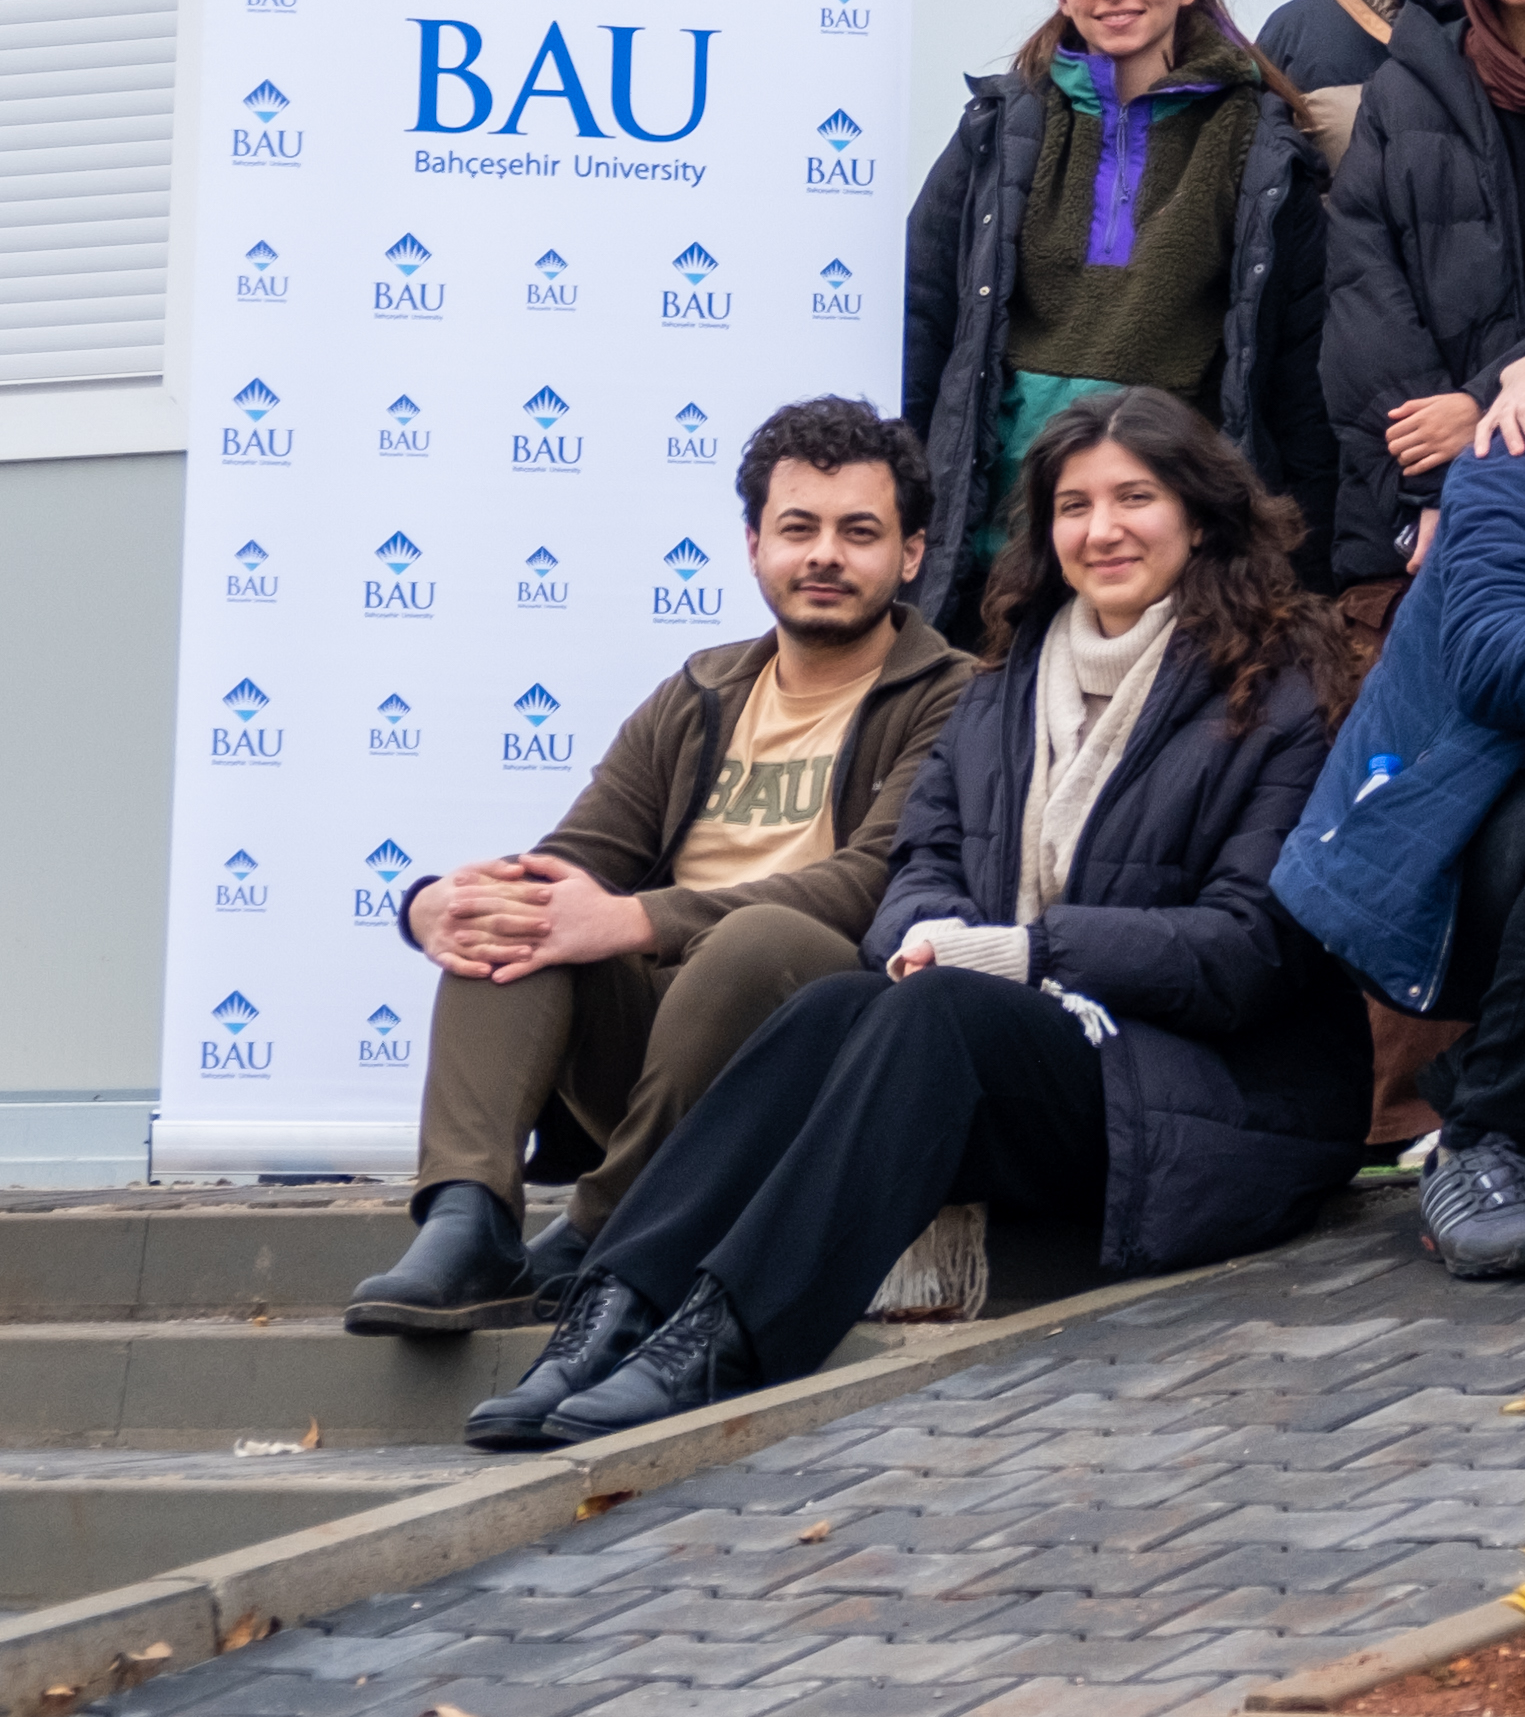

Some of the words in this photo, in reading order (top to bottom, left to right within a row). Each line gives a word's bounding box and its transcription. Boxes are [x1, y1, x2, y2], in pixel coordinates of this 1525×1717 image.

[819, 7, 871, 30] BAU
[402, 17, 723, 144] BAU
[230, 128, 305, 159] BAU
[414, 149, 562, 181] Bahçeşehir
[574, 154, 708, 189] University
[805, 156, 877, 187] BAU
[236, 274, 290, 298] BAU
[373, 281, 447, 312] BAU
[526, 283, 579, 306] BAU
[660, 290, 733, 321] BAU
[811, 292, 863, 315] BAU
[221, 427, 295, 458] BAU
[377, 429, 432, 452] BAU
[510, 434, 585, 465] BAU
[666, 436, 719, 459] BAU
[226, 575, 279, 598] BAU
[362, 580, 437, 611] BAU
[516, 581, 570, 604] BAU
[651, 586, 724, 616] BAU
[210, 727, 285, 758] BAU
[368, 728, 422, 751] BAU
[501, 732, 575, 763] BAU
[700, 754, 834, 827] BAU
[215, 884, 269, 907] BAU
[354, 888, 403, 918] BA
[200, 1040, 275, 1071] BAU
[358, 1039, 412, 1062] BAU
